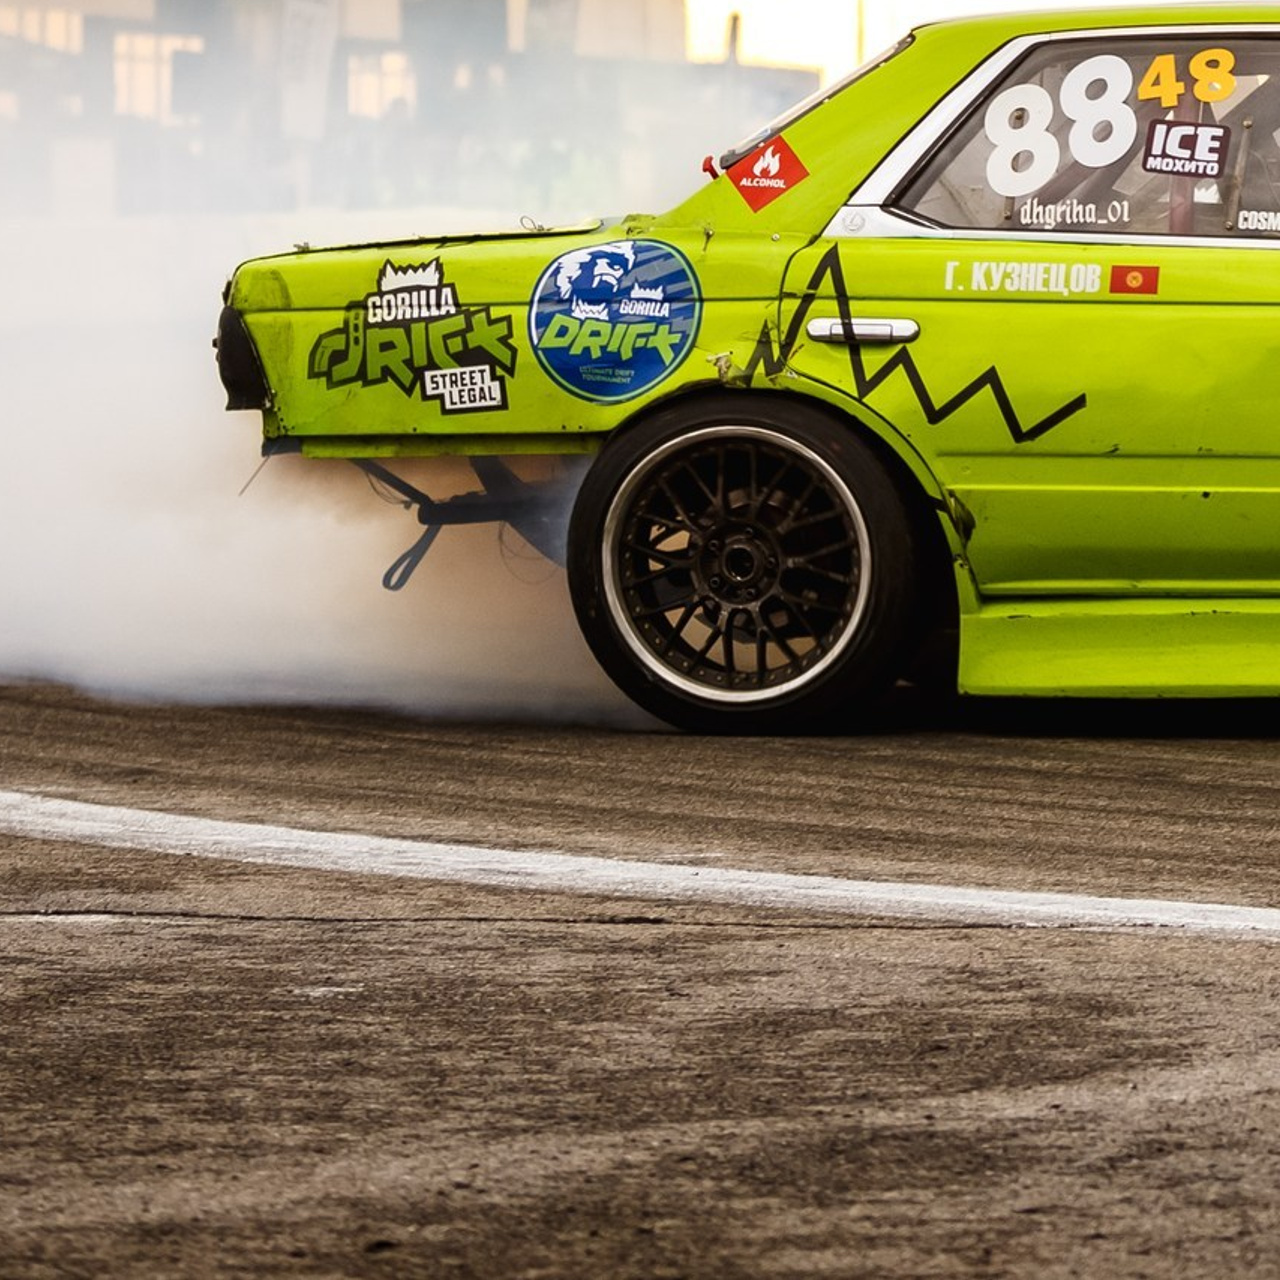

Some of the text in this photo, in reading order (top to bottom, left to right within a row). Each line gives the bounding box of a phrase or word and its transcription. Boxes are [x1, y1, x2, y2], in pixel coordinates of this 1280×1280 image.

[1137, 48, 1237, 108] 48
[984, 54, 1138, 197] 88
[1150, 123, 1224, 161] ICE
[740, 177, 786, 189] ALCOHOL
[1146, 156, 1220, 176] МОХИТО
[944, 261, 1102, 297] Г. КУЗНЕЦОВ
[367, 287, 457, 324] GORILLA
[619, 299, 670, 318] GORILLA
[538, 313, 682, 366] DRIFT
[430, 369, 487, 391] STREET
[450, 386, 497, 406] LEGAL
